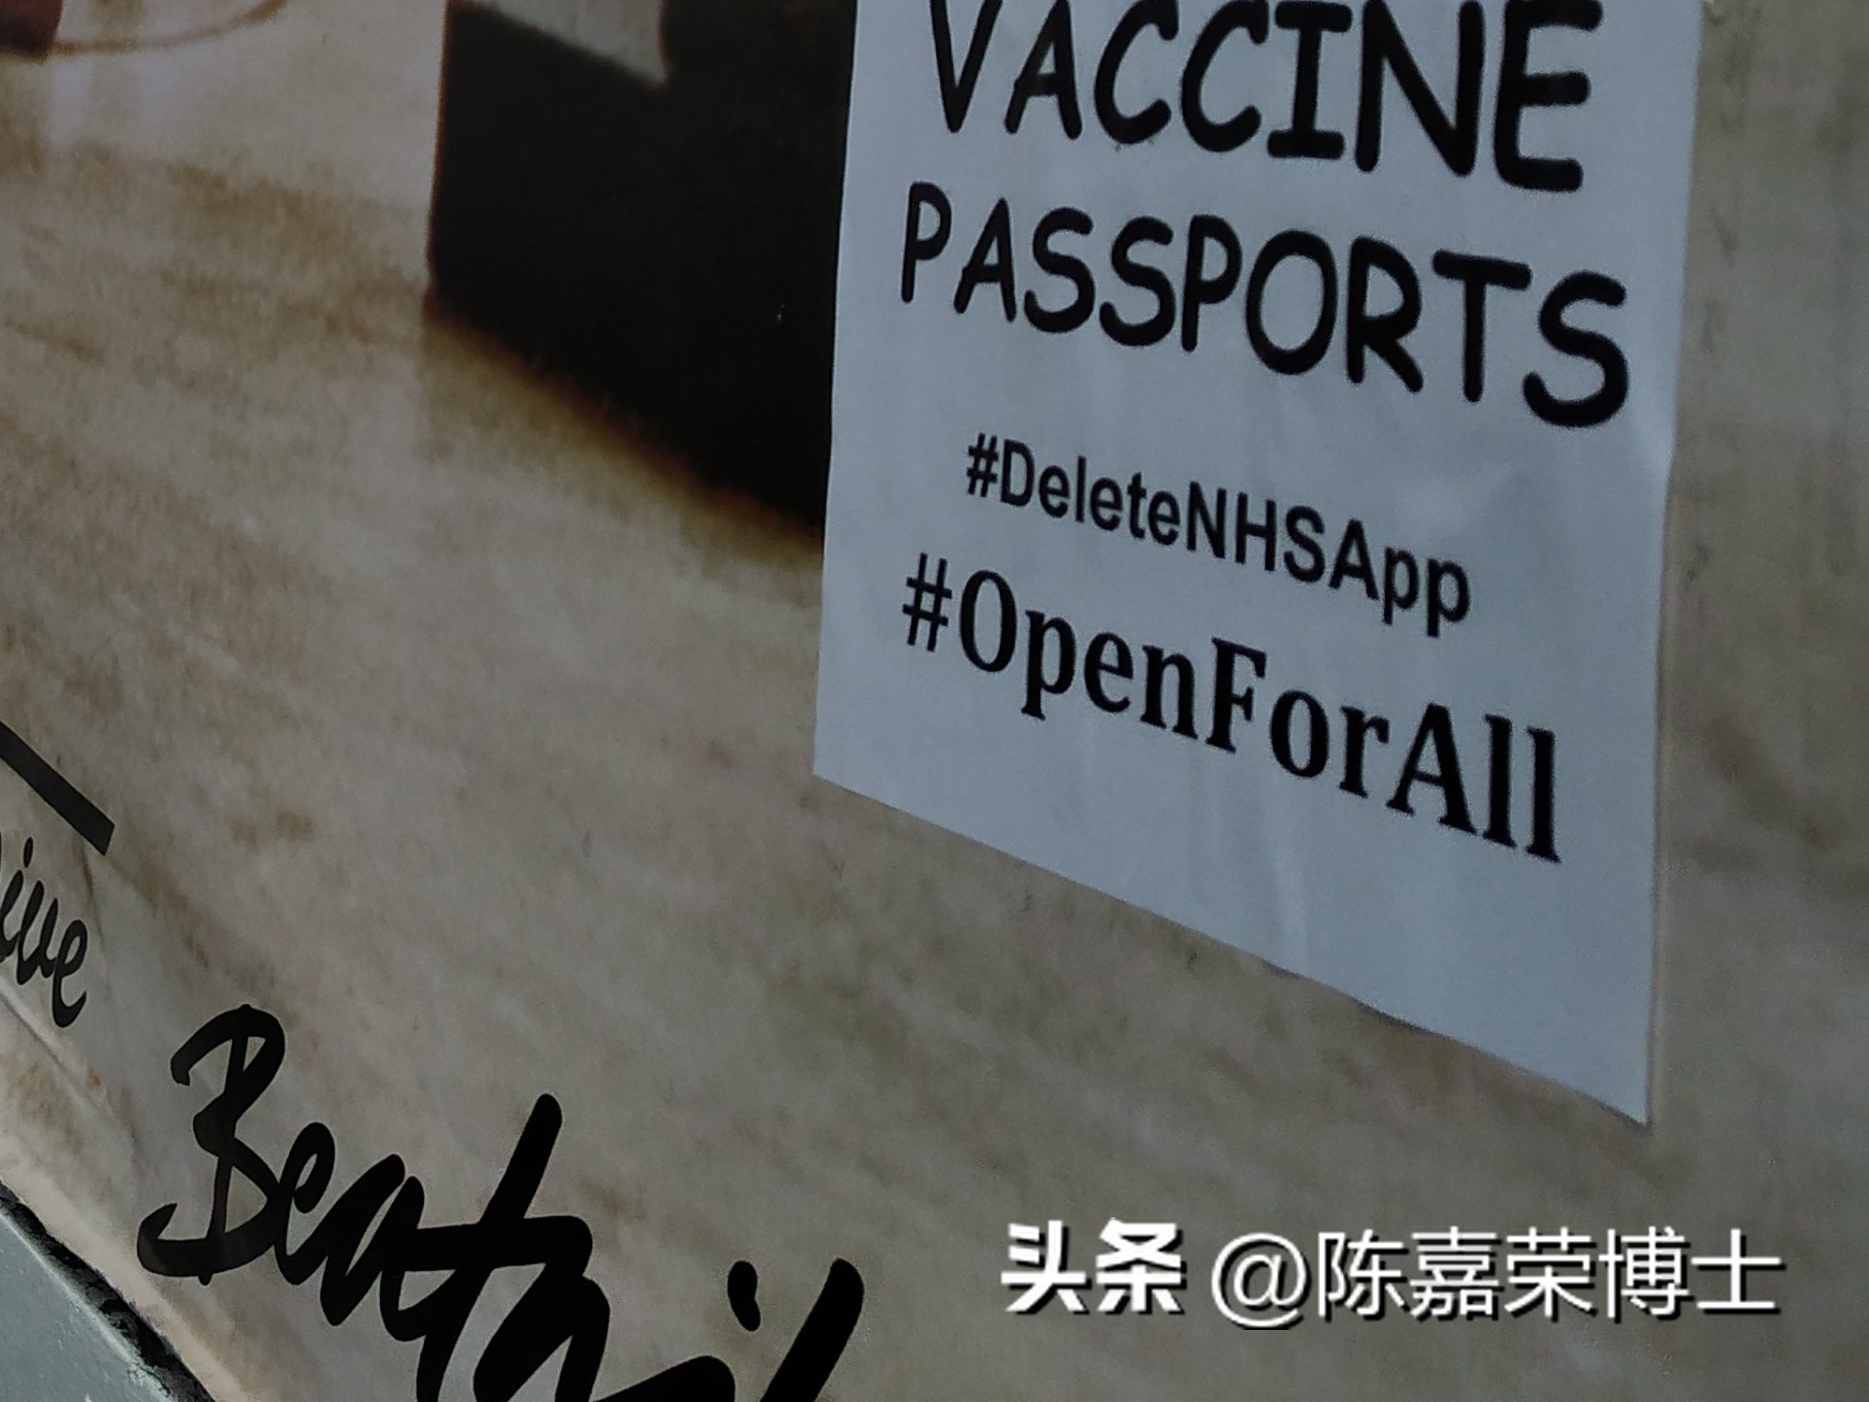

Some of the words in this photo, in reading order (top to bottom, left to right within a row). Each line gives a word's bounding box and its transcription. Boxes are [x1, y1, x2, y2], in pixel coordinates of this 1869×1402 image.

[900, 181, 1632, 430] PASSPORTS
[965, 431, 1473, 637] #DeleteNHSApp
[900, 551, 1563, 865] #OpenForAll
